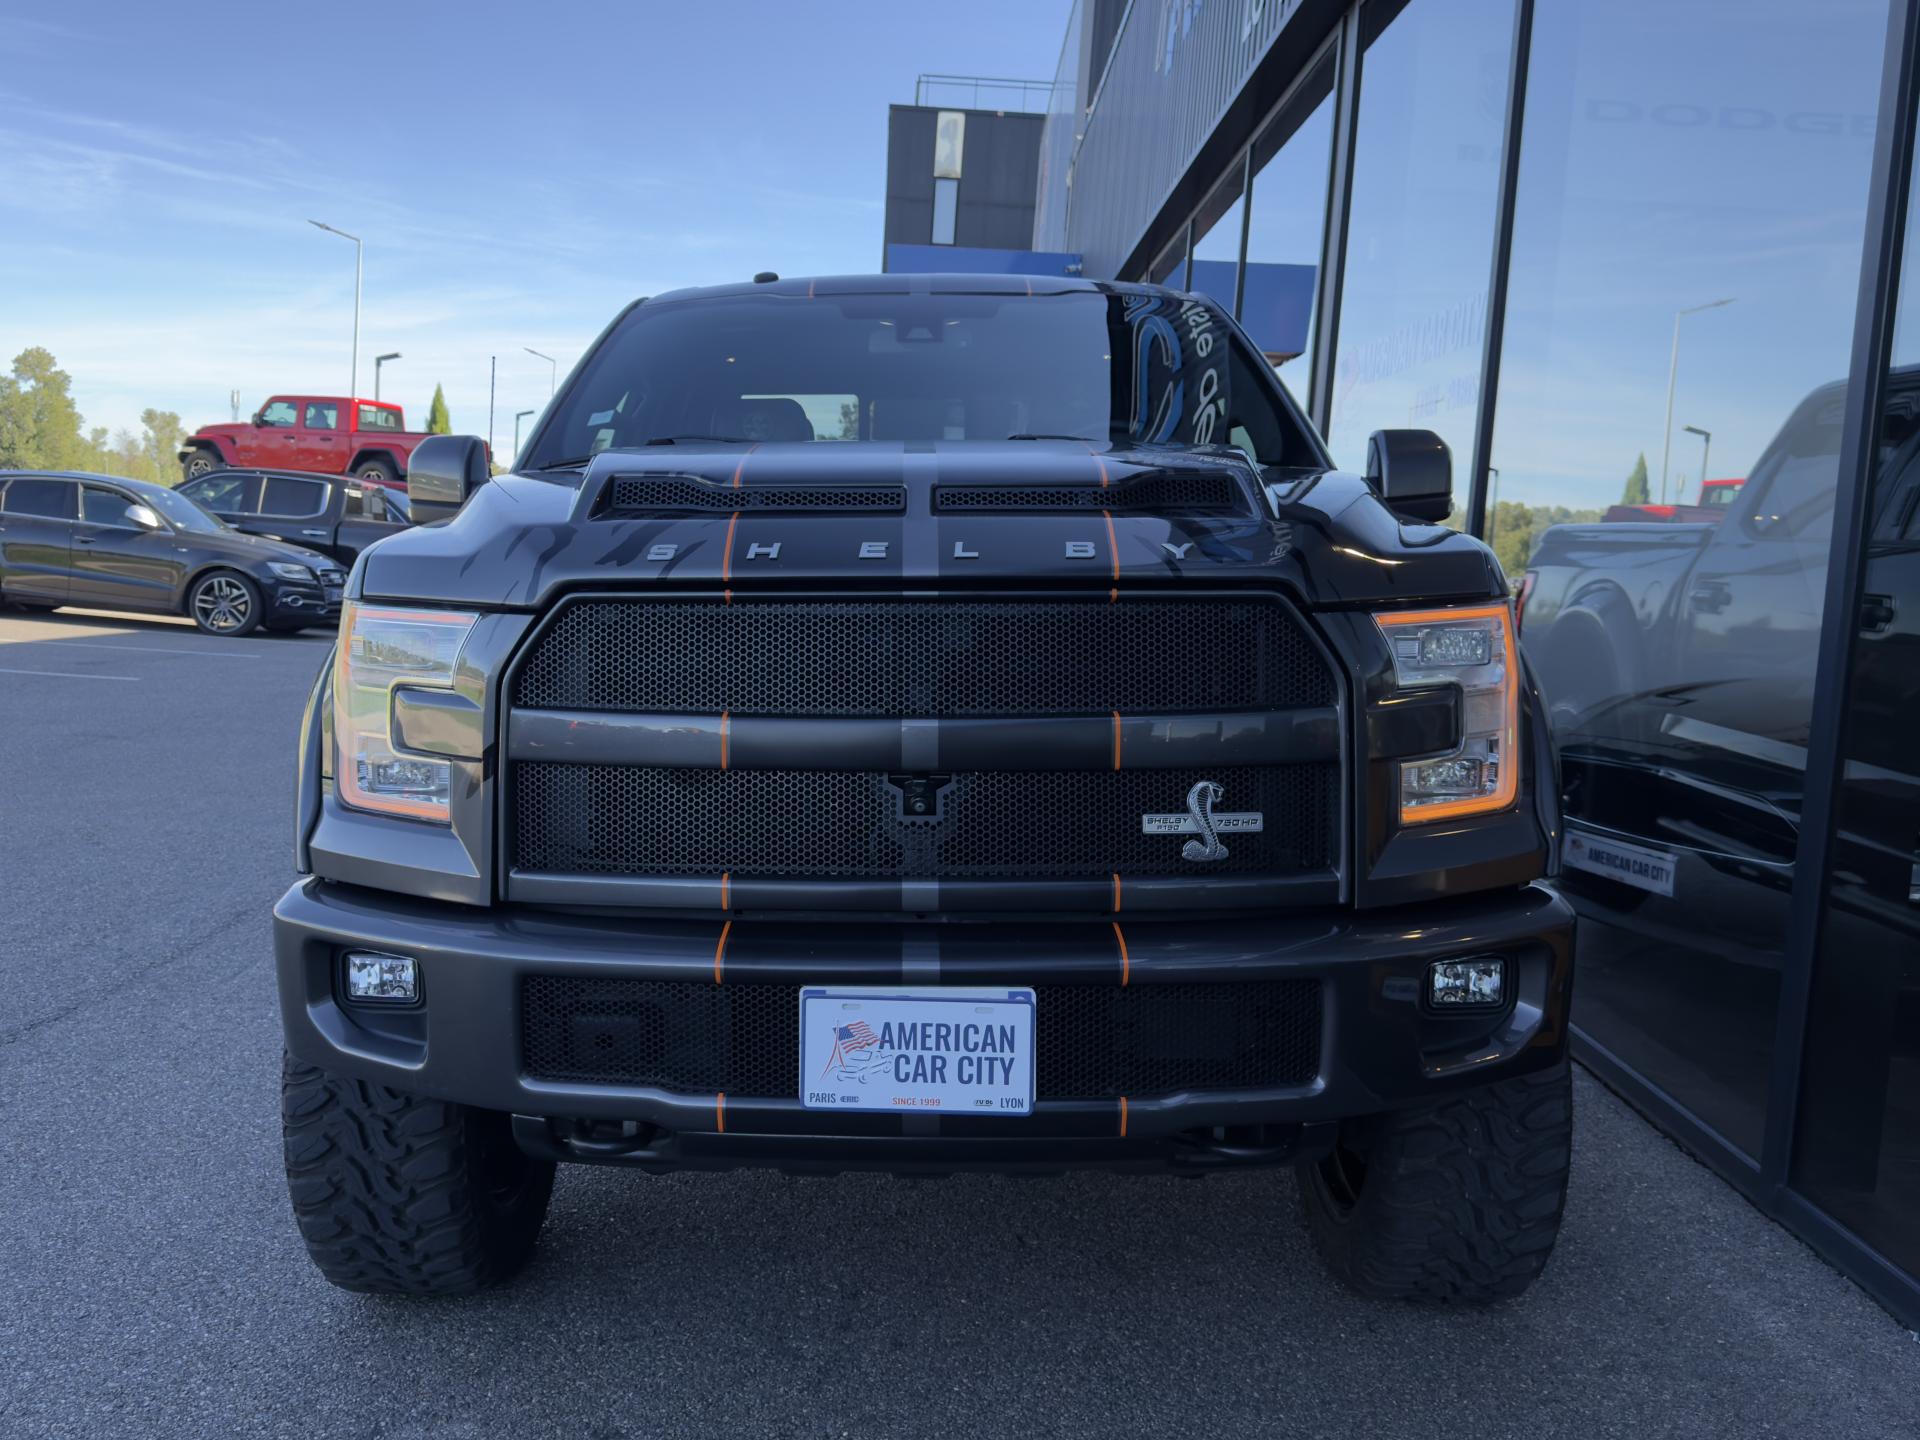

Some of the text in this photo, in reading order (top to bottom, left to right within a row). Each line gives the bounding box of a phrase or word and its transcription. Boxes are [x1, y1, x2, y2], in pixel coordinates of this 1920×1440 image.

[647, 541, 1193, 560] SHELBY
[1217, 818, 1259, 827] 750 HP
[1588, 848, 1631, 872] AMERICAN
[1632, 860, 1650, 878] CAR
[1651, 865, 1671, 884] CITY
[879, 1022, 1015, 1053] AMERICAN
[894, 1054, 1015, 1085] CAR CITY
[809, 1092, 836, 1104] PARIS
[892, 1097, 941, 1106] SINCE 1999
[1000, 1097, 1024, 1109] LYON
